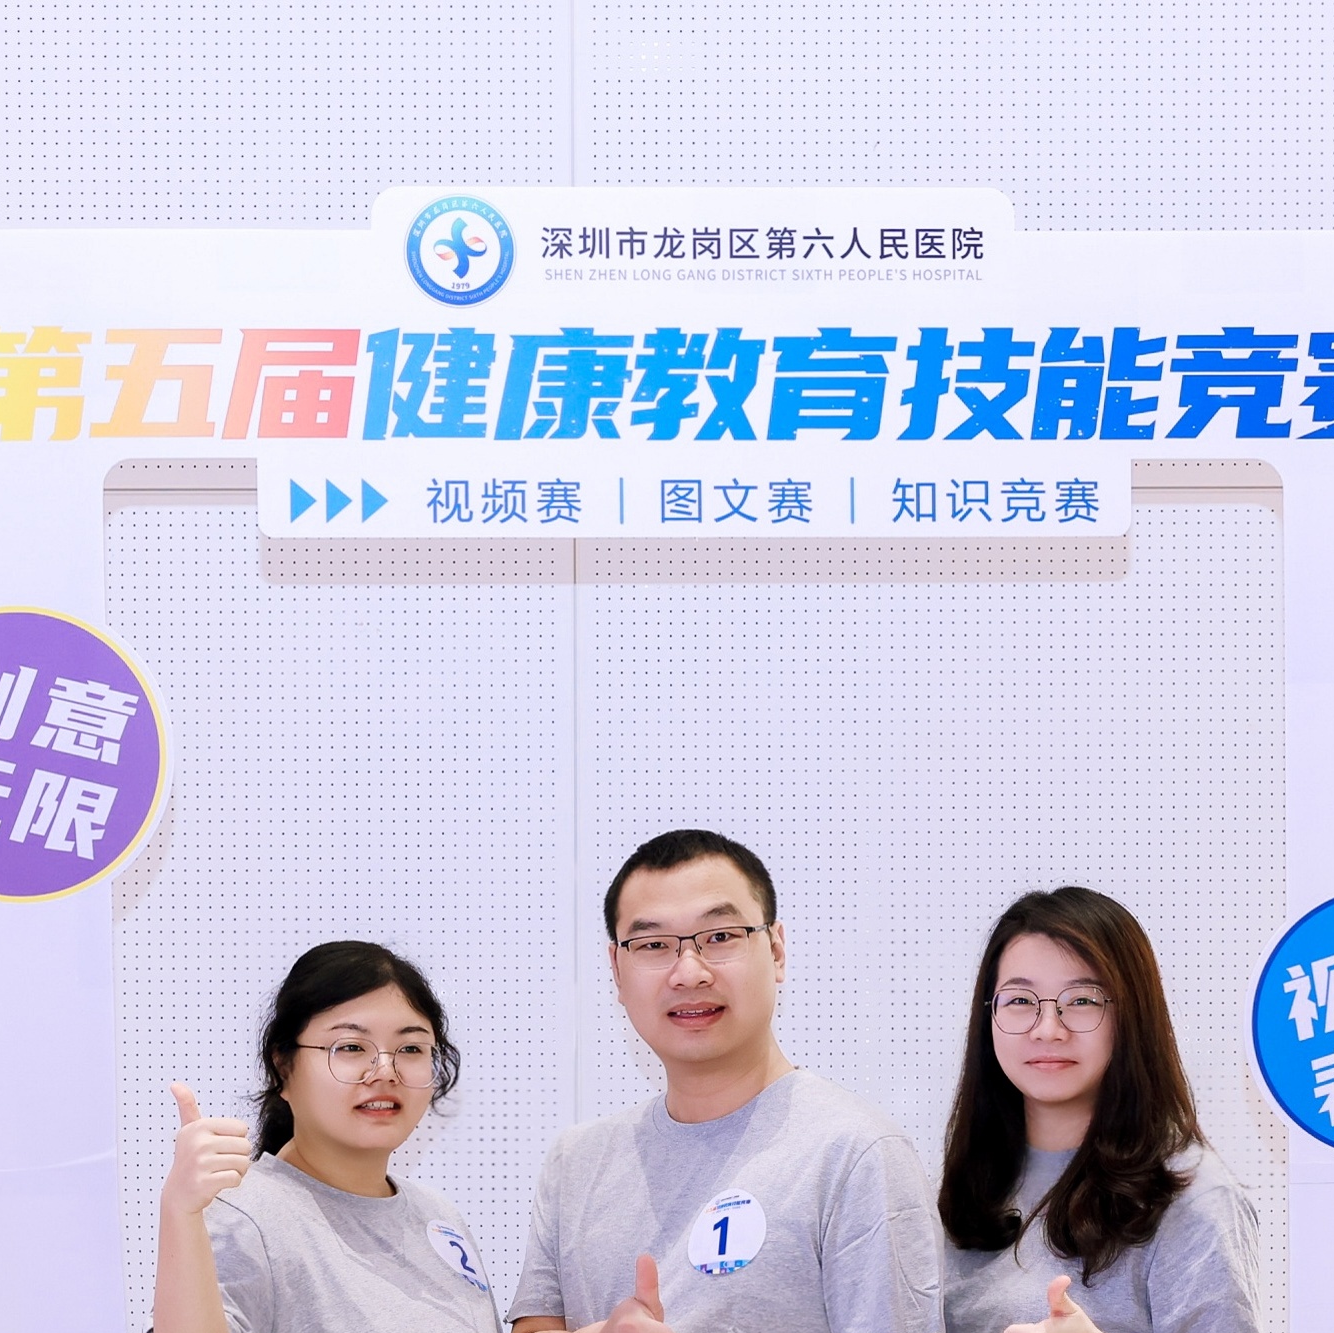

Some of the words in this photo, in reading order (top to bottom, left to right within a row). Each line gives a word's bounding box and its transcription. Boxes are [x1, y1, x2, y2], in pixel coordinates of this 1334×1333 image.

[540, 226, 985, 260] 深圳市龙岗区第六人民医院
[451, 282, 470, 290] 1979
[544, 268, 584, 282] SHEN
[588, 268, 628, 282] ZHEN
[632, 268, 672, 282] LONG
[676, 268, 717, 282] GANG
[722, 268, 787, 282] DISTRICT
[792, 268, 834, 282] SIXTH
[838, 268, 907, 282] PEOPLE'S
[912, 268, 984, 282] HOSPITAL
[425, 477, 583, 526] 视频赛
[659, 477, 814, 525] 图文赛
[891, 477, 1101, 524] 知识竞赛
[713, 1216, 729, 1256] 1
[449, 1240, 477, 1275] 2
